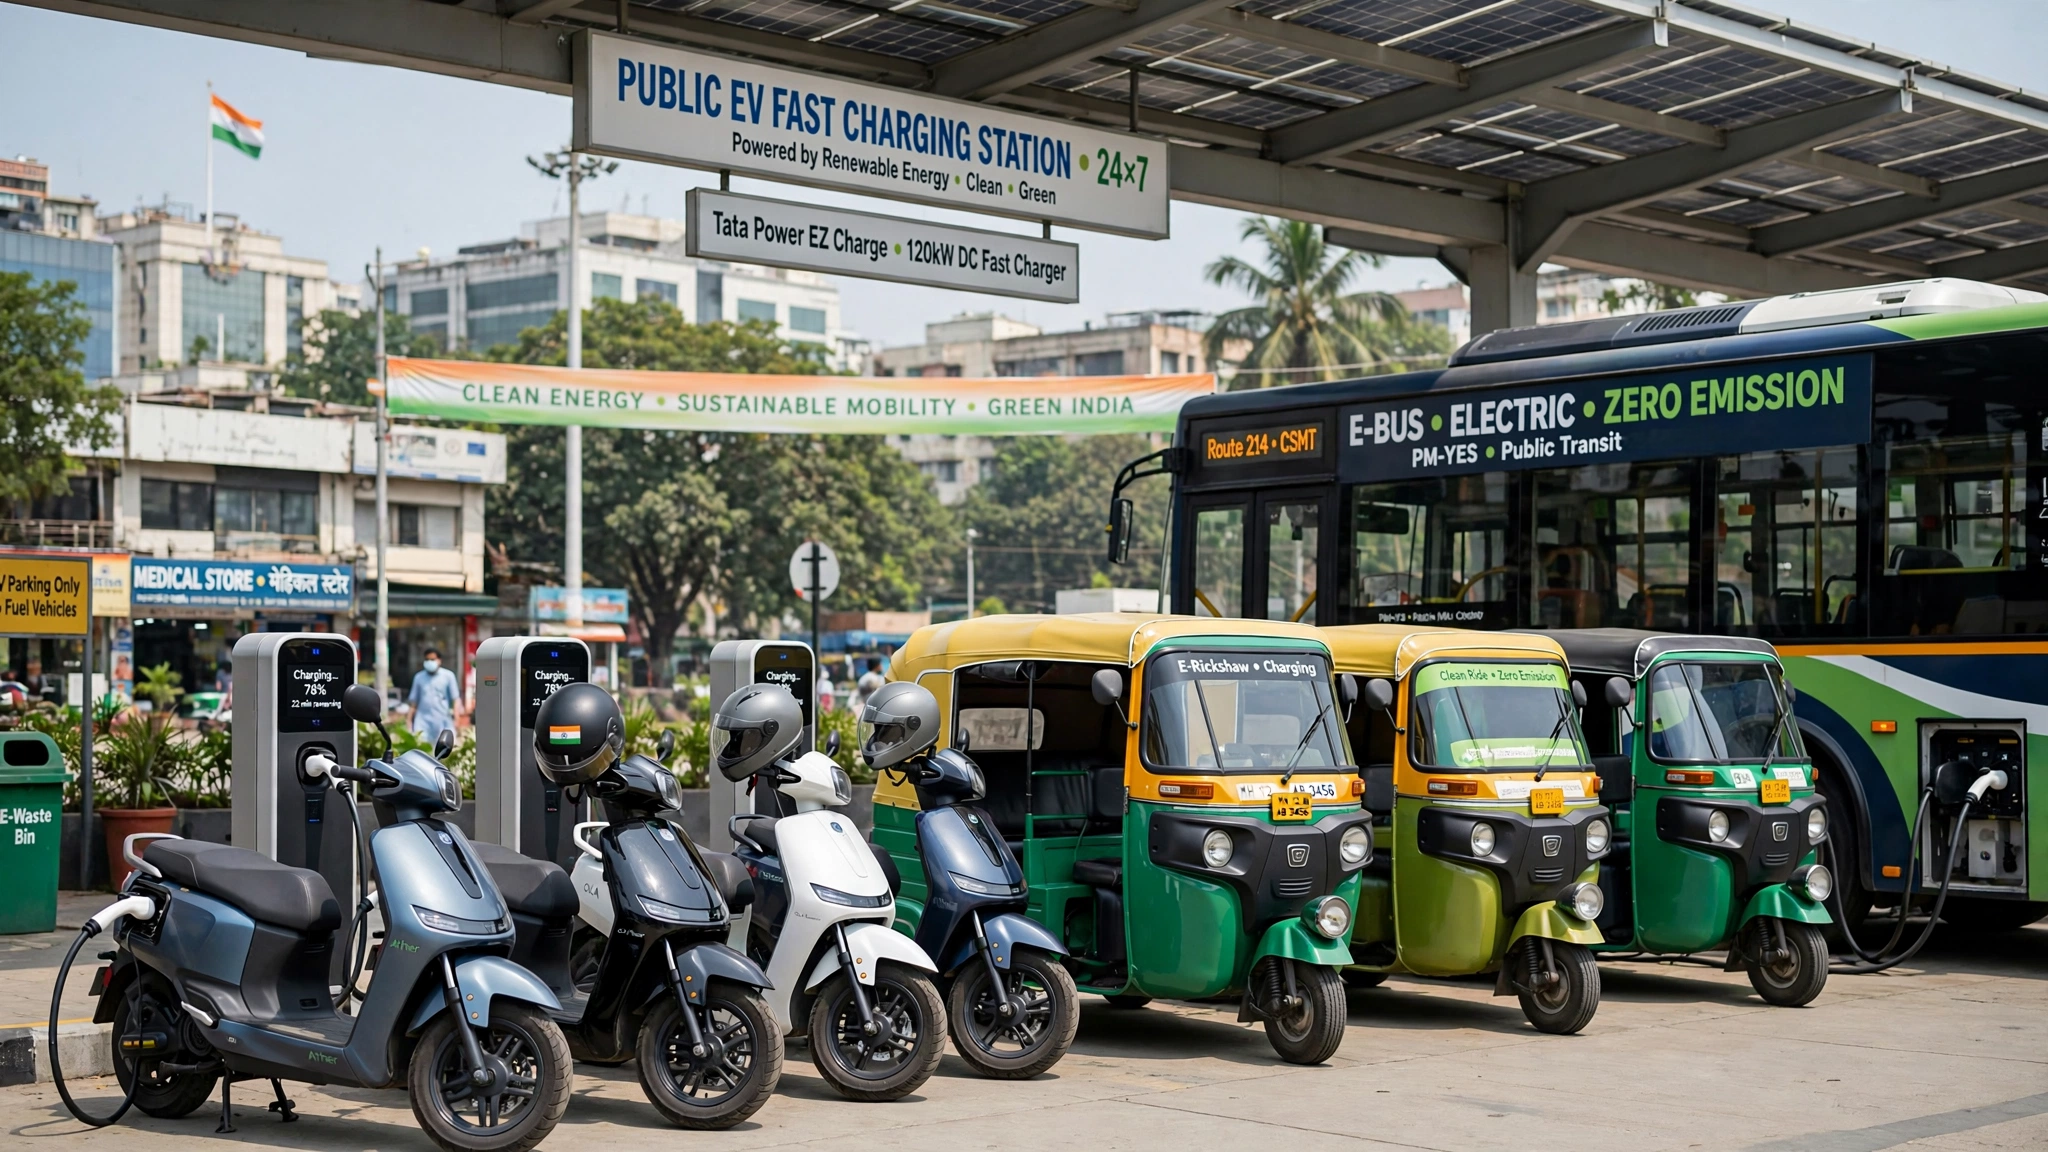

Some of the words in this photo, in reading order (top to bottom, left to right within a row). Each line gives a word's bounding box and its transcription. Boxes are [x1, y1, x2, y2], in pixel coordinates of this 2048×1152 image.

[618, 57, 722, 118] PUBLIC
[731, 78, 764, 125] EV
[772, 86, 836, 137] FAST
[843, 99, 970, 162] CHARGING
[978, 125, 1071, 179] STATION
[732, 131, 796, 162] Powered
[801, 143, 818, 170] by
[823, 147, 898, 179] Renewable
[903, 161, 949, 191] Energy
[966, 172, 1003, 196] Clean
[1019, 180, 1056, 204] Green
[713, 210, 749, 239] Tata
[753, 216, 804, 246] Power
[809, 225, 830, 250] EZ
[834, 228, 888, 261] Charge
[907, 238, 955, 267] 120kW
[958, 245, 978, 270] DC
[982, 248, 1010, 274] Fast
[1014, 253, 1067, 285] Charger
[463, 383, 540, 405] CLEAN
[551, 387, 644, 410] ENERGY
[678, 393, 836, 415] SUSTAINABLE
[847, 397, 956, 416] MOBILITY
[988, 398, 1061, 416] GREEN
[1073, 396, 1134, 415] INDIA
[1349, 408, 1424, 446] E-BUS
[1450, 392, 1576, 438] ELECTRIC
[1603, 382, 1682, 424] ZERO
[1690, 366, 1845, 417] EMISSION
[1207, 438, 1244, 460] Route
[1246, 433, 1269, 456] 214
[1280, 428, 1317, 453] CSMT
[1412, 443, 1478, 468] PM-YES
[1501, 437, 1555, 460] Public
[1559, 431, 1622, 455] Transit
[8, 575, 51, 597] Parking
[54, 576, 80, 597] Only
[133, 565, 202, 590] MEDICAL
[205, 567, 254, 592] STORE
[321, 567, 350, 594] स्टोर
[5, 598, 29, 616] Fuel
[32, 599, 77, 617] Vehicles
[1177, 659, 1249, 673] E-Rickshaw
[1263, 660, 1317, 677] Charging
[1440, 669, 1466, 681] Clean
[1468, 669, 1488, 680] Ride
[1497, 669, 1517, 680] Zero
[0, 808, 52, 824] E-Waste
[15, 828, 35, 845] Bin
